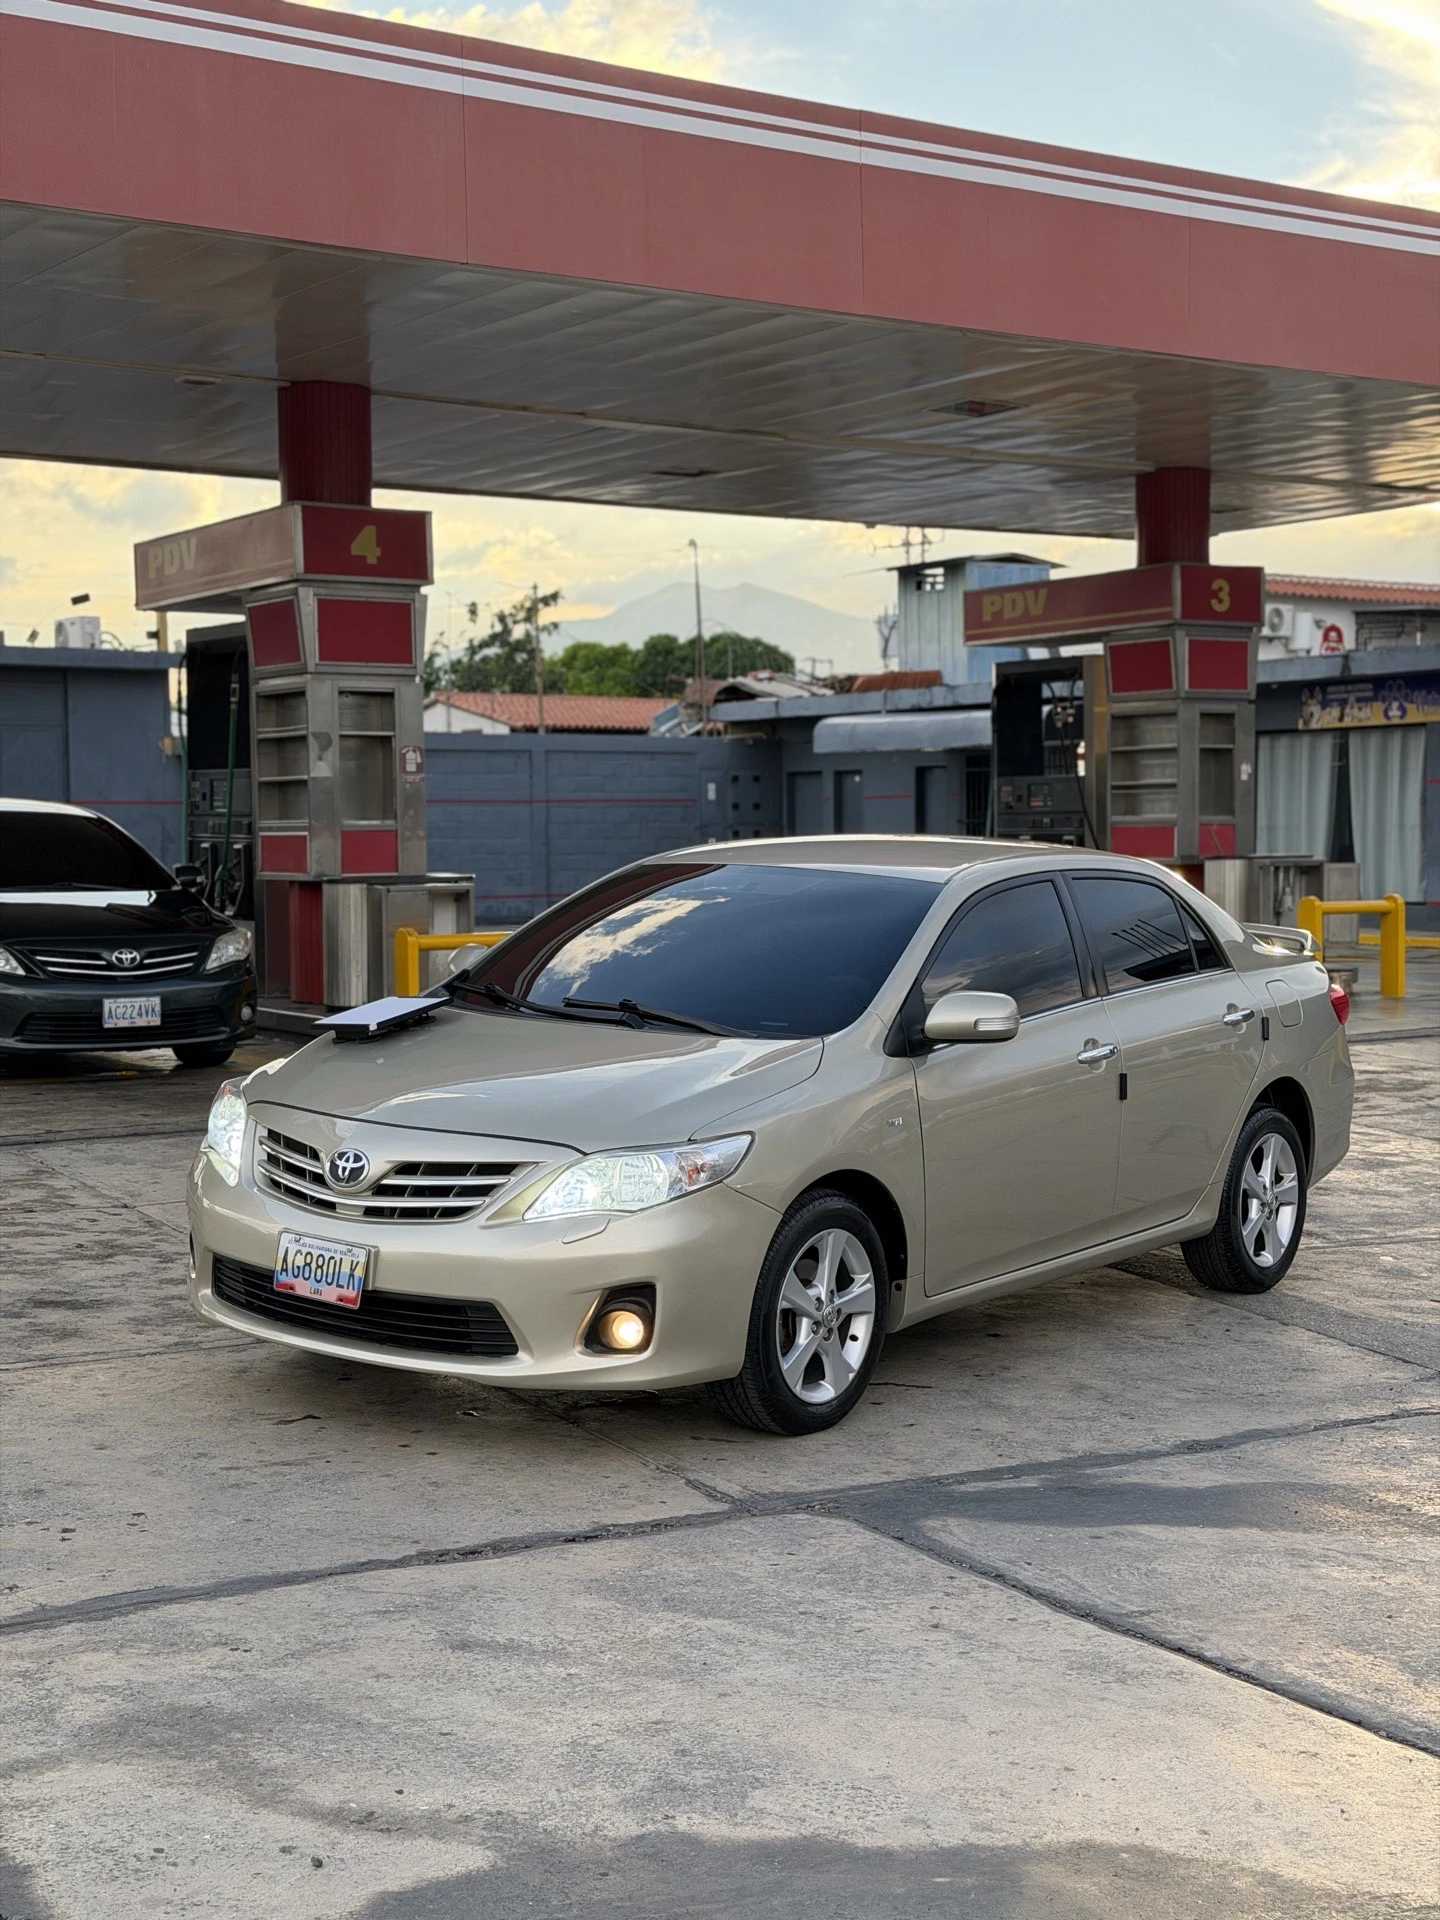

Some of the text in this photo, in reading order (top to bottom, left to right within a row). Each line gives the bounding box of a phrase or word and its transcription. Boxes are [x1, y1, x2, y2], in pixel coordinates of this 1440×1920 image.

[149, 537, 198, 579] PDV
[350, 525, 381, 565] 4
[982, 588, 1047, 622] PDV
[1210, 578, 1230, 612] 3
[107, 1003, 157, 1021] AC224VK
[280, 1246, 360, 1291] AG880LK
[309, 1286, 323, 1297] LARA
